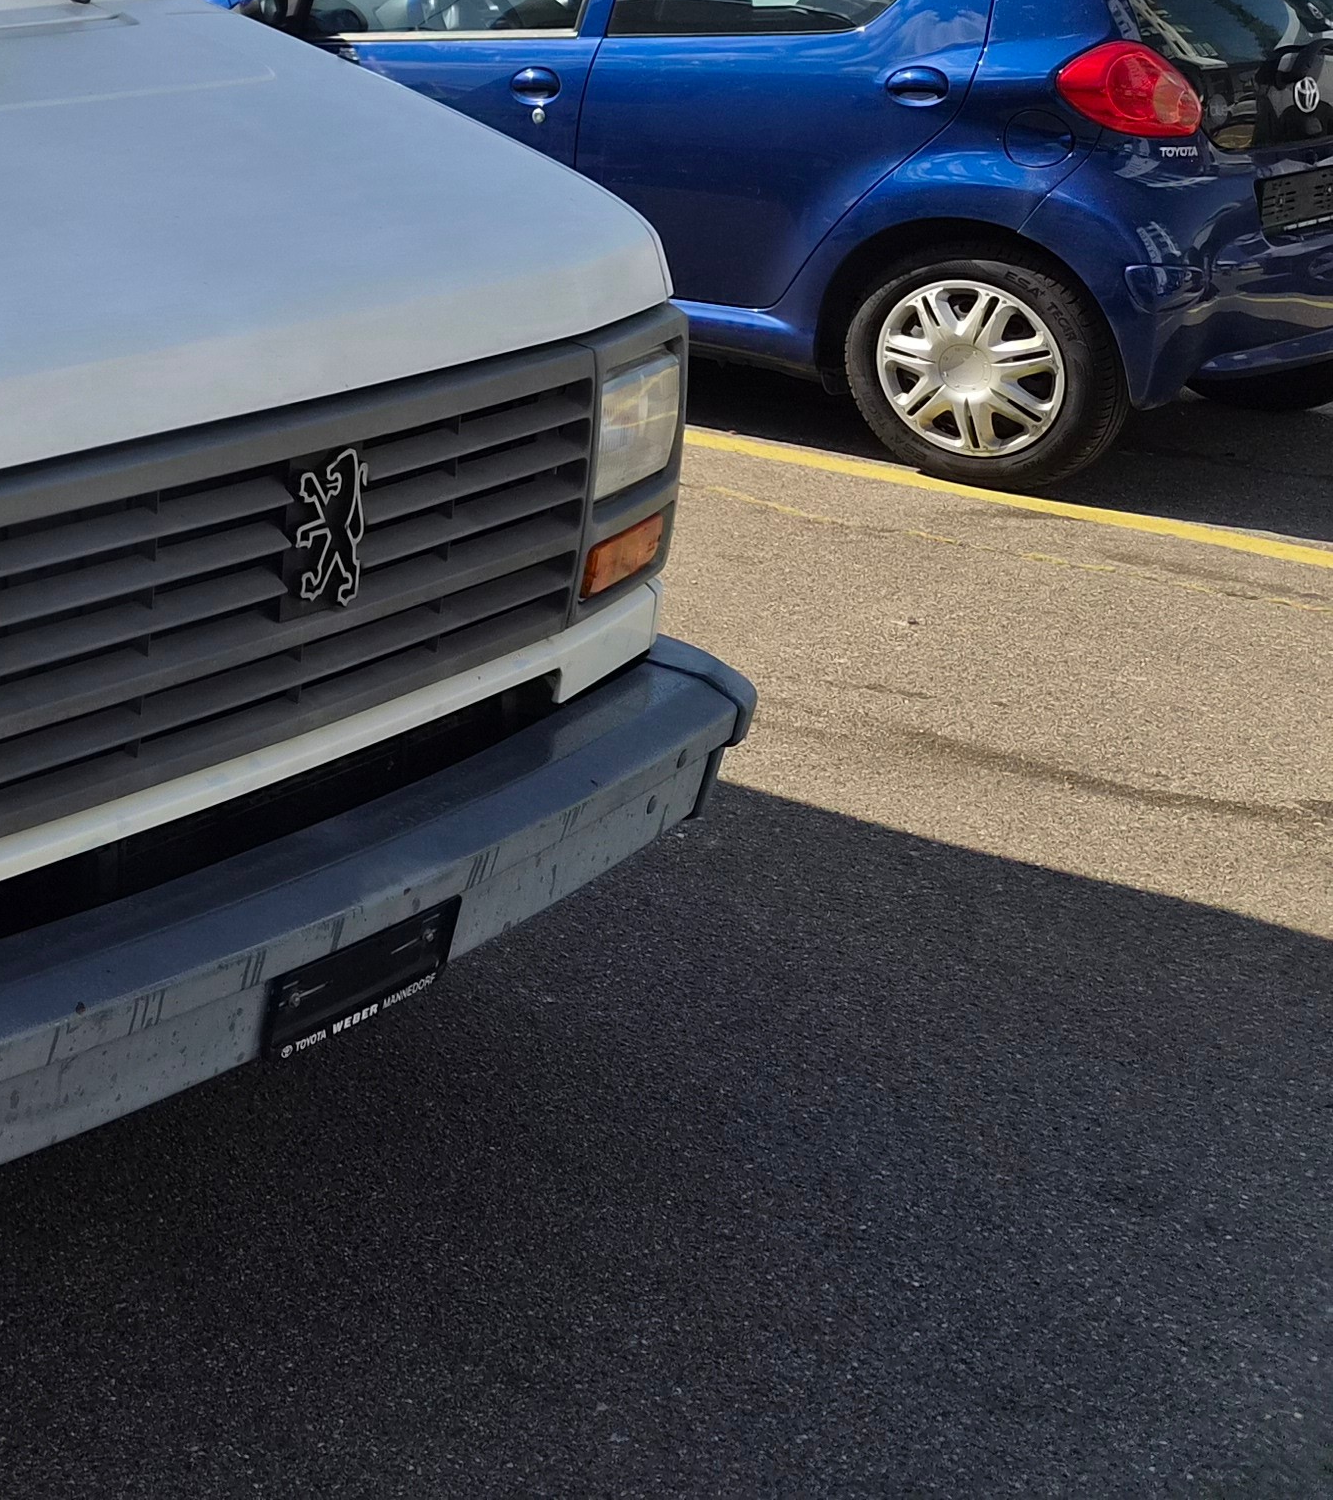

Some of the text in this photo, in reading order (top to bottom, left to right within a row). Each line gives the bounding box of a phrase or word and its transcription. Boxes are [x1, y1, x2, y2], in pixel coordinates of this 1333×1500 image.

[1159, 146, 1199, 158] TOYOTA
[295, 1029, 327, 1052] TOYOTA
[333, 1003, 379, 1035] WEBER
